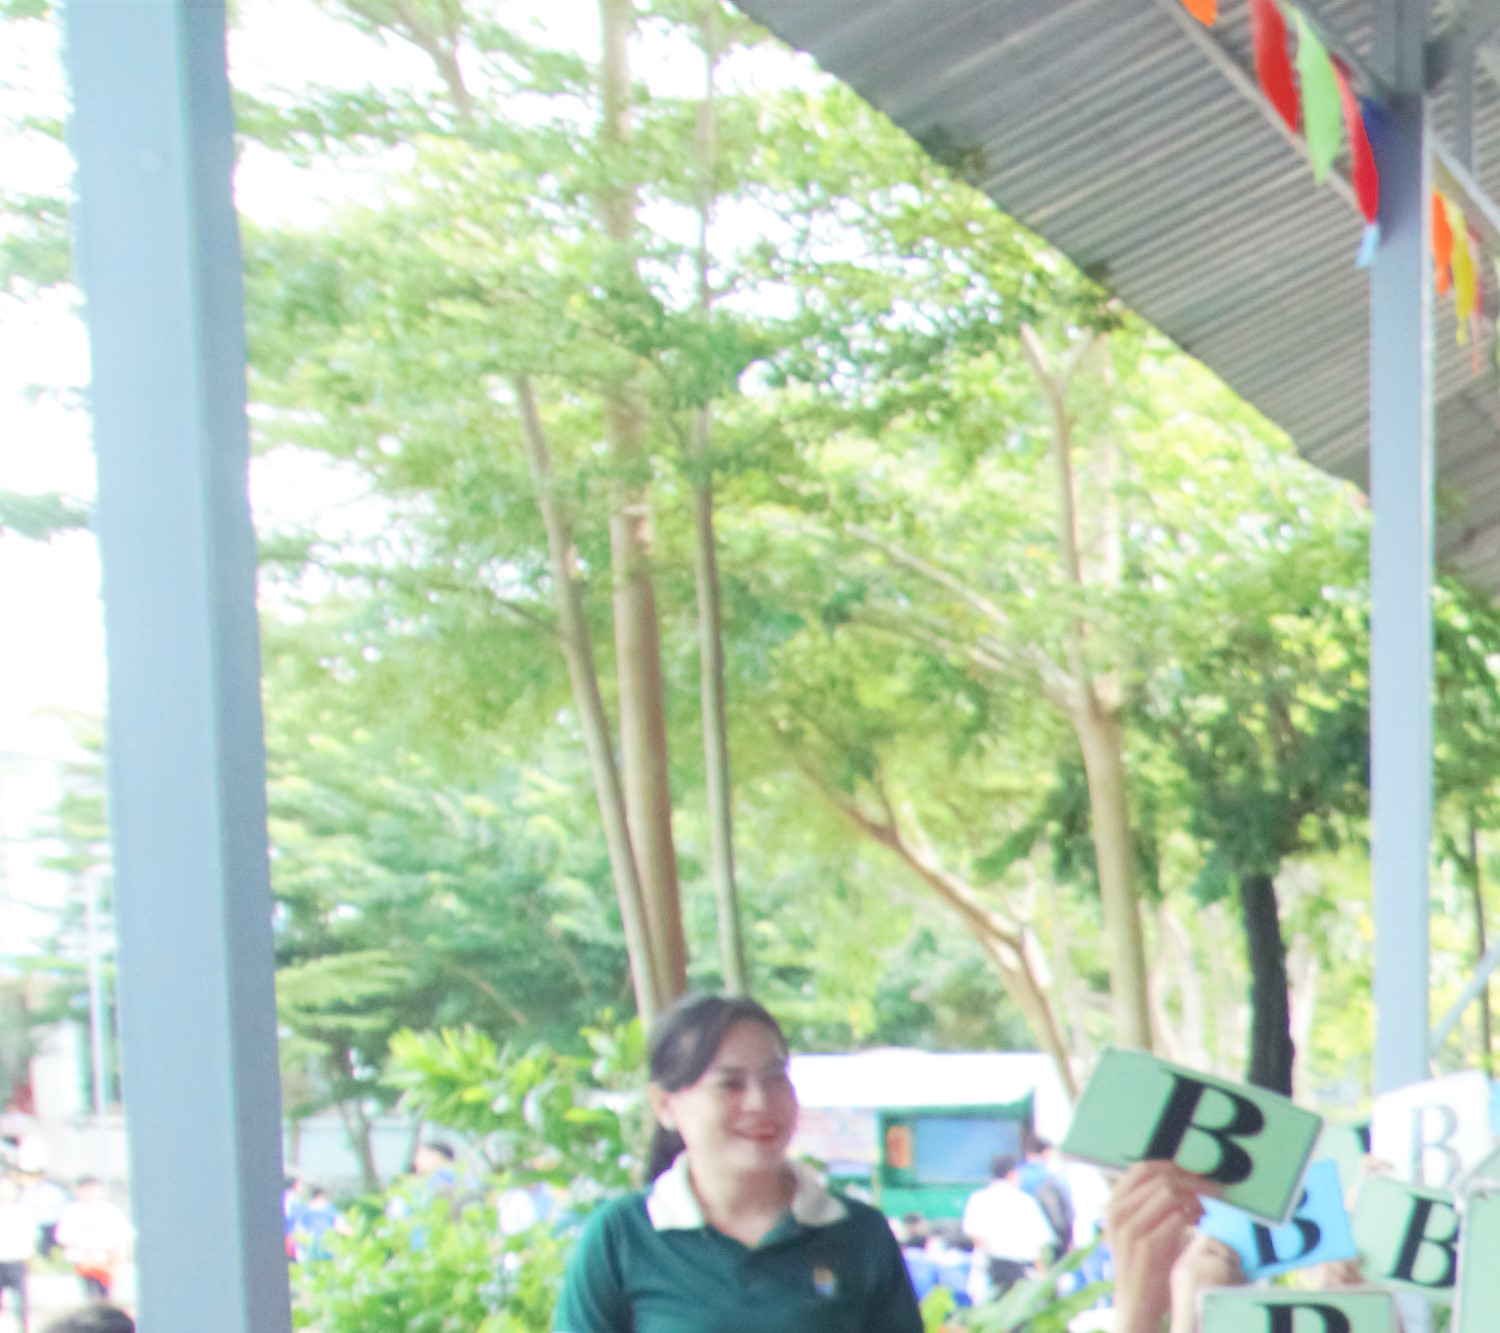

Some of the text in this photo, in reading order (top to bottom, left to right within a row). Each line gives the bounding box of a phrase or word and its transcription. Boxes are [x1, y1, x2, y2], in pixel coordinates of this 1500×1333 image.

[1125, 1068, 1265, 1186] B
[1409, 1105, 1466, 1187] B
[1387, 1195, 1457, 1288] B
